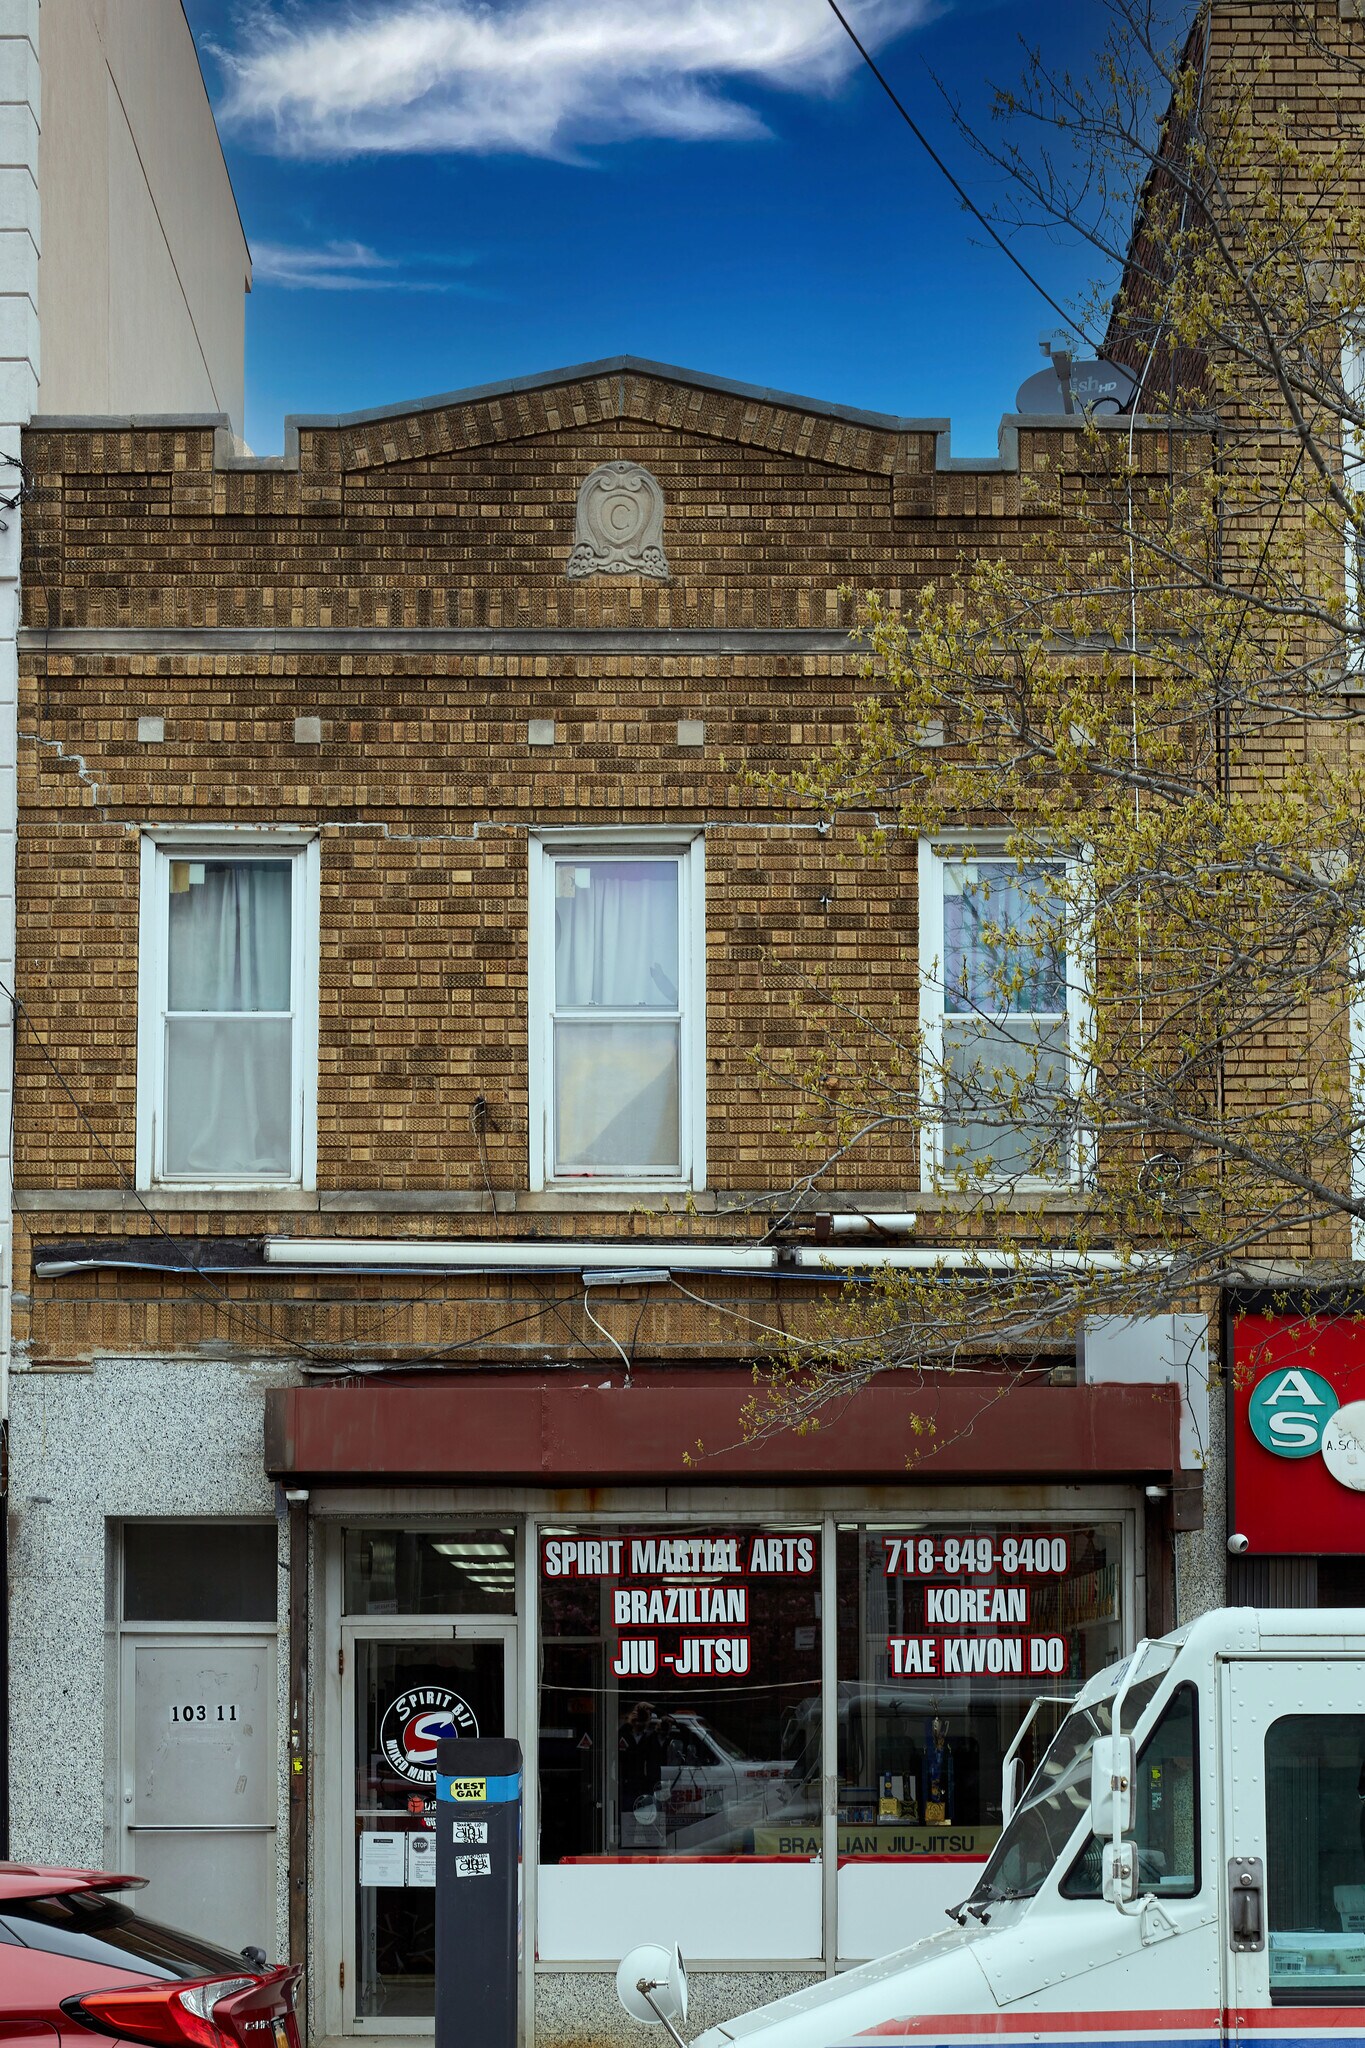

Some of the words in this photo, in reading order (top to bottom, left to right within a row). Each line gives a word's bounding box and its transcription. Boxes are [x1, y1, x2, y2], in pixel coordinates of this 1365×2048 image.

[1098, 381, 1117, 393] HD
[610, 504, 631, 531] C
[545, 1540, 624, 1576] SPIRIT
[631, 1538, 742, 1574] MARTIAL
[750, 1537, 814, 1573] ARTS
[885, 1538, 1067, 1574] 718-849-8400
[614, 1588, 746, 1624] BRAZILIAN
[927, 1588, 1027, 1623] KOREAN
[613, 1639, 656, 1675] JIU
[890, 1639, 936, 1673] TAE
[944, 1638, 1022, 1673] KWON
[1030, 1637, 1064, 1673] DO
[172, 1705, 206, 1722] 103
[217, 1705, 237, 1721] 11
[395, 1691, 453, 1722] SPIRIT
[451, 1702, 474, 1728] BJJ
[386, 1739, 409, 1772] MIXED
[455, 1782, 485, 1790] KEST
[457, 1790, 482, 1798] GAK
[413, 1841, 428, 1849] STOP
[779, 1837, 878, 1854] BRALIAN
[888, 1835, 975, 1852] JIU-JITSU
